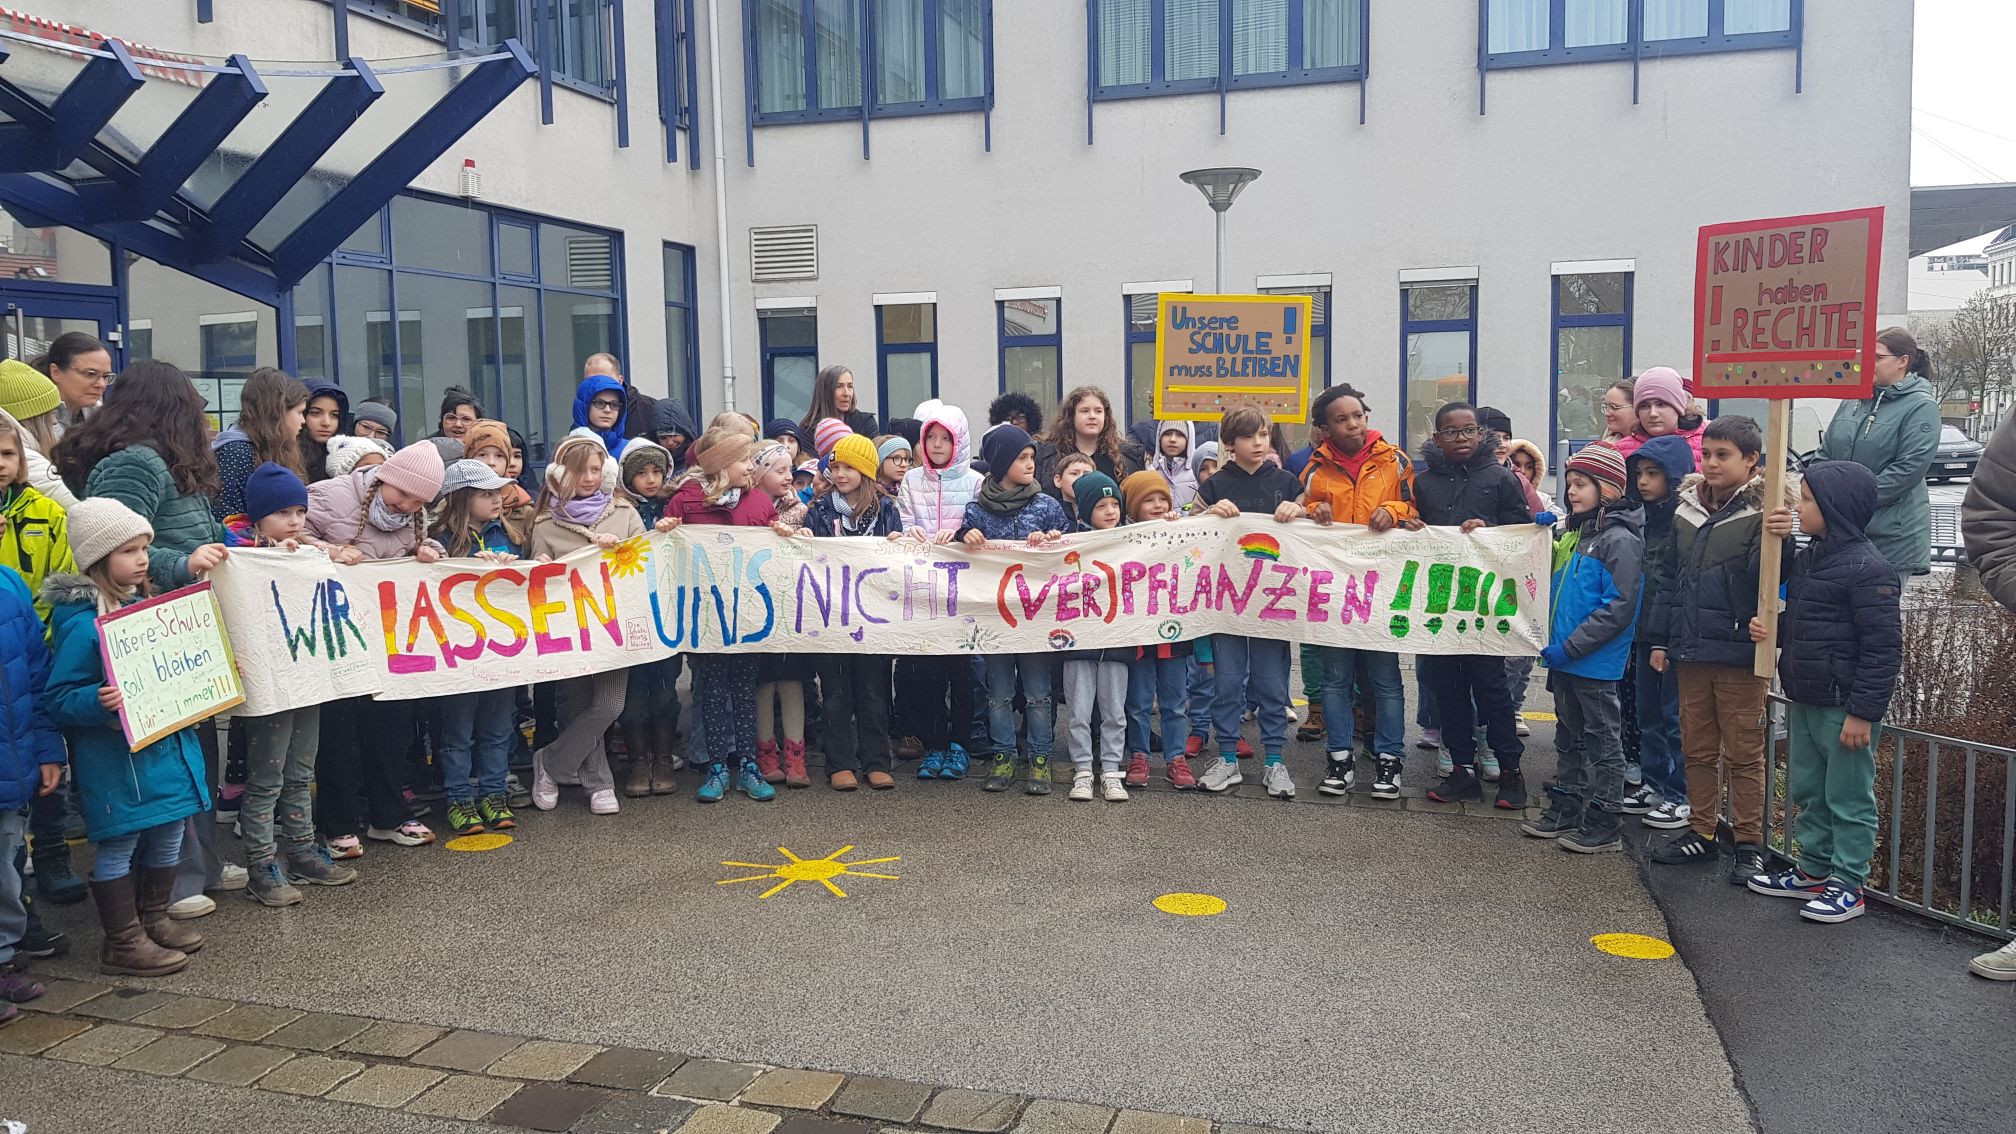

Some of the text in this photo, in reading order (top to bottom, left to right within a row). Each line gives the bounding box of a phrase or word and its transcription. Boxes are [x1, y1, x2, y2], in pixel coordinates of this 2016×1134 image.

[1713, 227, 1830, 275] KINDER
[1758, 277, 1828, 306] haben
[1171, 306, 1239, 331] Unsere
[1732, 302, 1862, 351] RECHTE
[1169, 354, 1300, 379] muss BLEIBEN
[271, 579, 368, 662] WIR
[378, 562, 624, 674] LASSEN
[646, 542, 775, 649] UNS
[795, 561, 970, 634] NICHT
[152, 649, 212, 682] bleiben
